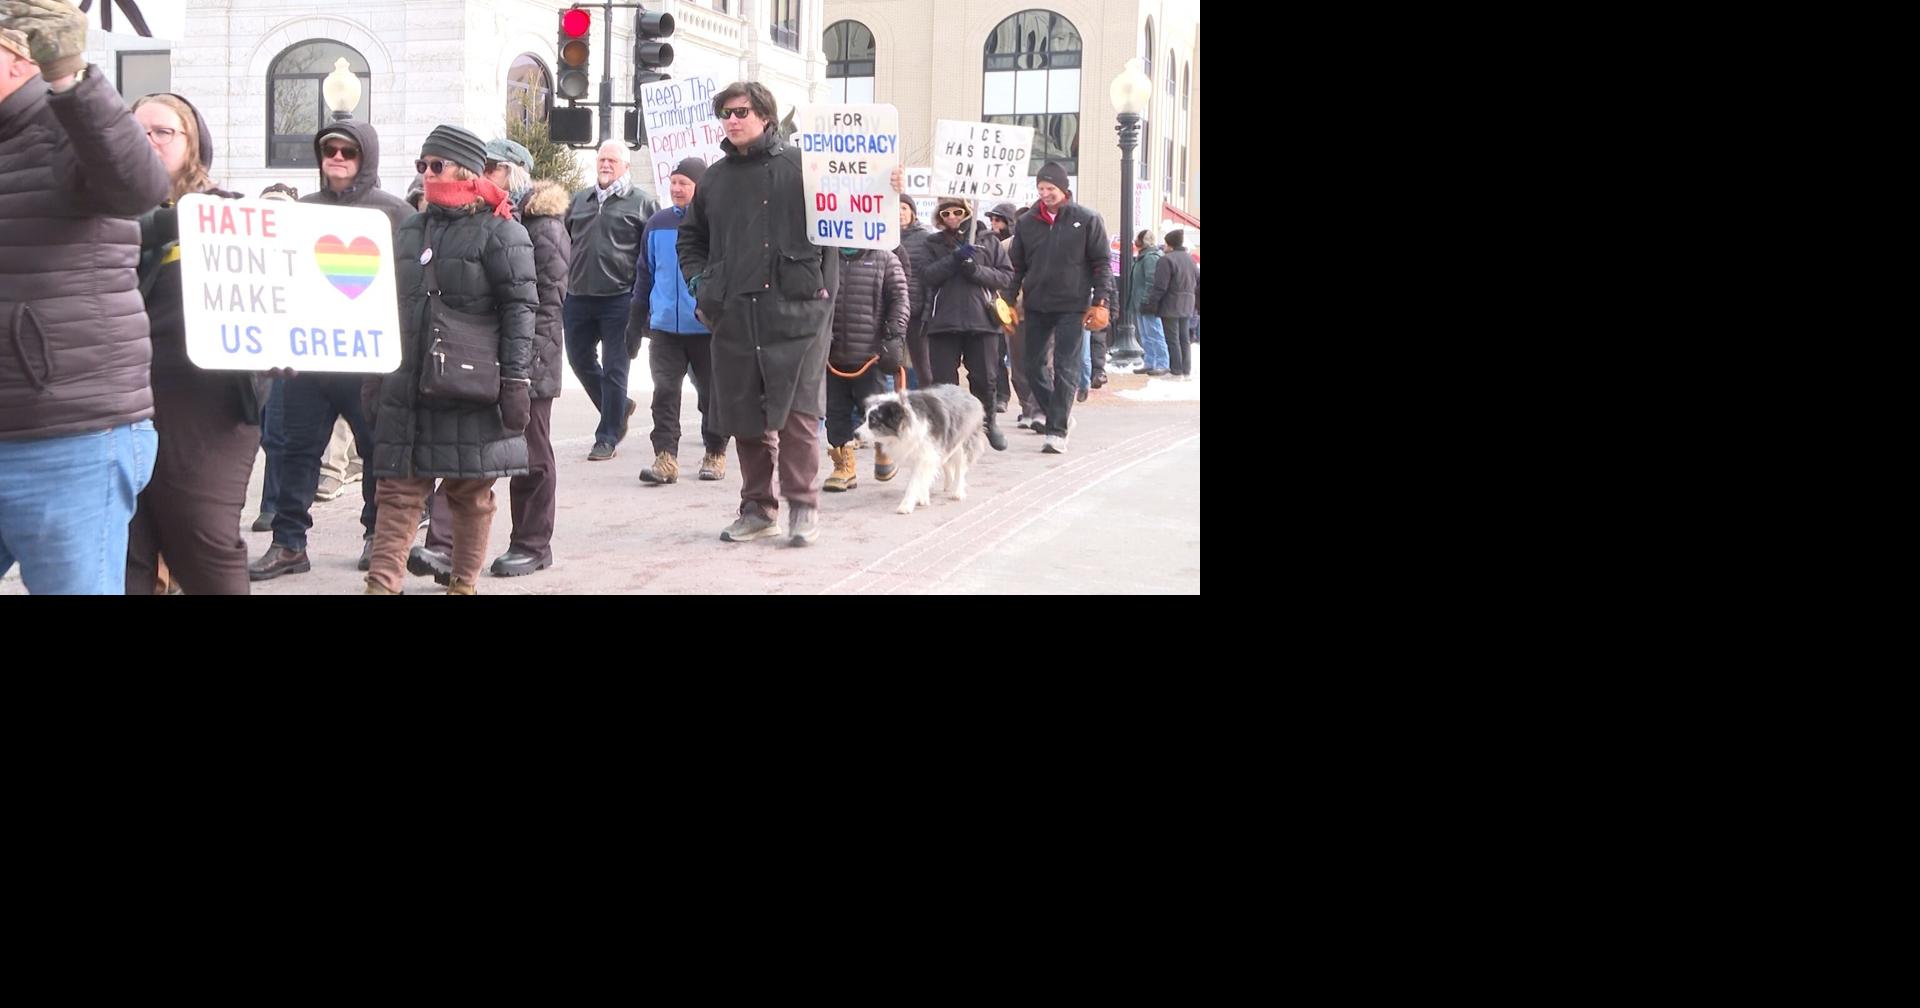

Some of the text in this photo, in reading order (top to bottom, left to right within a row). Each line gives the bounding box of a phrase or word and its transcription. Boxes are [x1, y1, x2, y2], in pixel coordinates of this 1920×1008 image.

[646, 77, 716, 109] Keep The
[833, 113, 862, 126] FOR
[651, 124, 725, 158] Deport The
[803, 134, 896, 154] DEMOCRACY
[970, 126, 1001, 144] ICE
[945, 141, 1026, 162] HAS BLOOD
[828, 160, 868, 174] SAKE
[956, 162, 1016, 178] ON IT'S
[948, 181, 1017, 198] HANDS!!
[816, 192, 884, 214] DO NOT
[198, 204, 277, 238] HATE
[818, 219, 886, 240] GIVE UP
[202, 243, 297, 277] WON'T
[203, 282, 287, 314] MAKE
[221, 324, 384, 358] US GREAT
